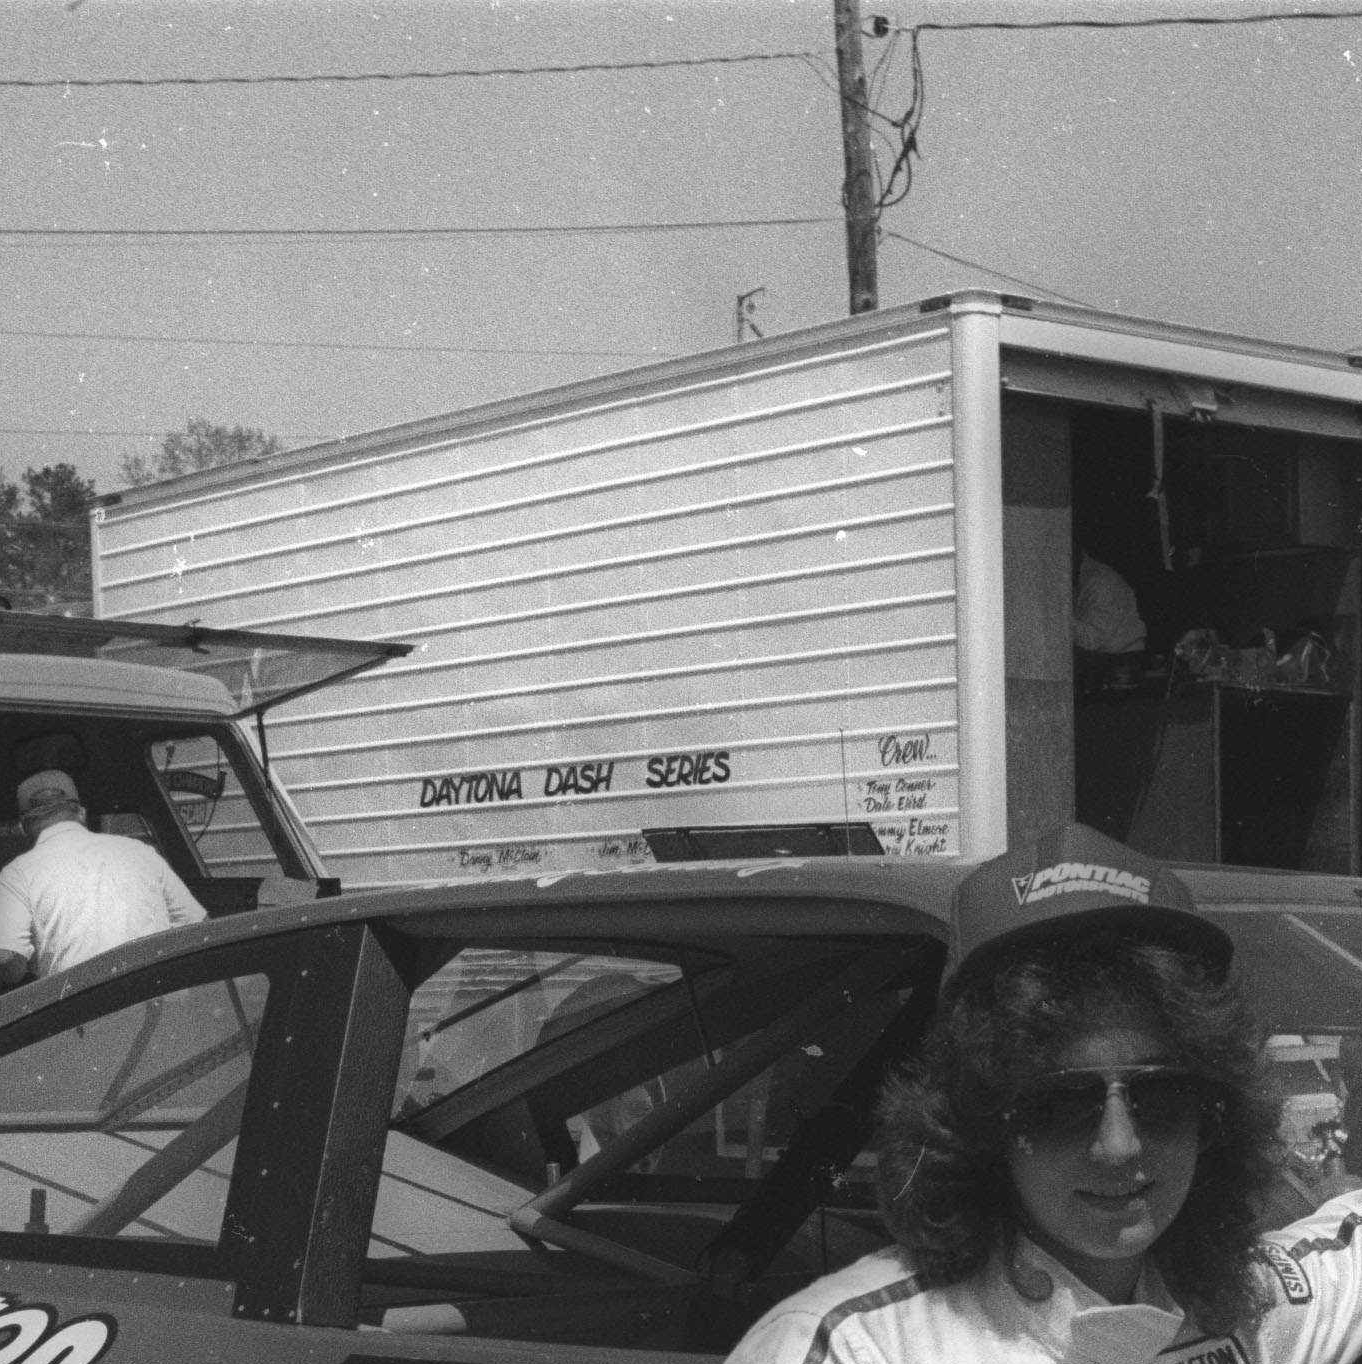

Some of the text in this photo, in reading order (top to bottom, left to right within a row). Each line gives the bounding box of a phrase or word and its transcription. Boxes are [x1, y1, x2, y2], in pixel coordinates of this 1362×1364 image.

[420, 750, 731, 808] DAYTONA DASH SERIES
[1032, 862, 1152, 893] PONTIAC
